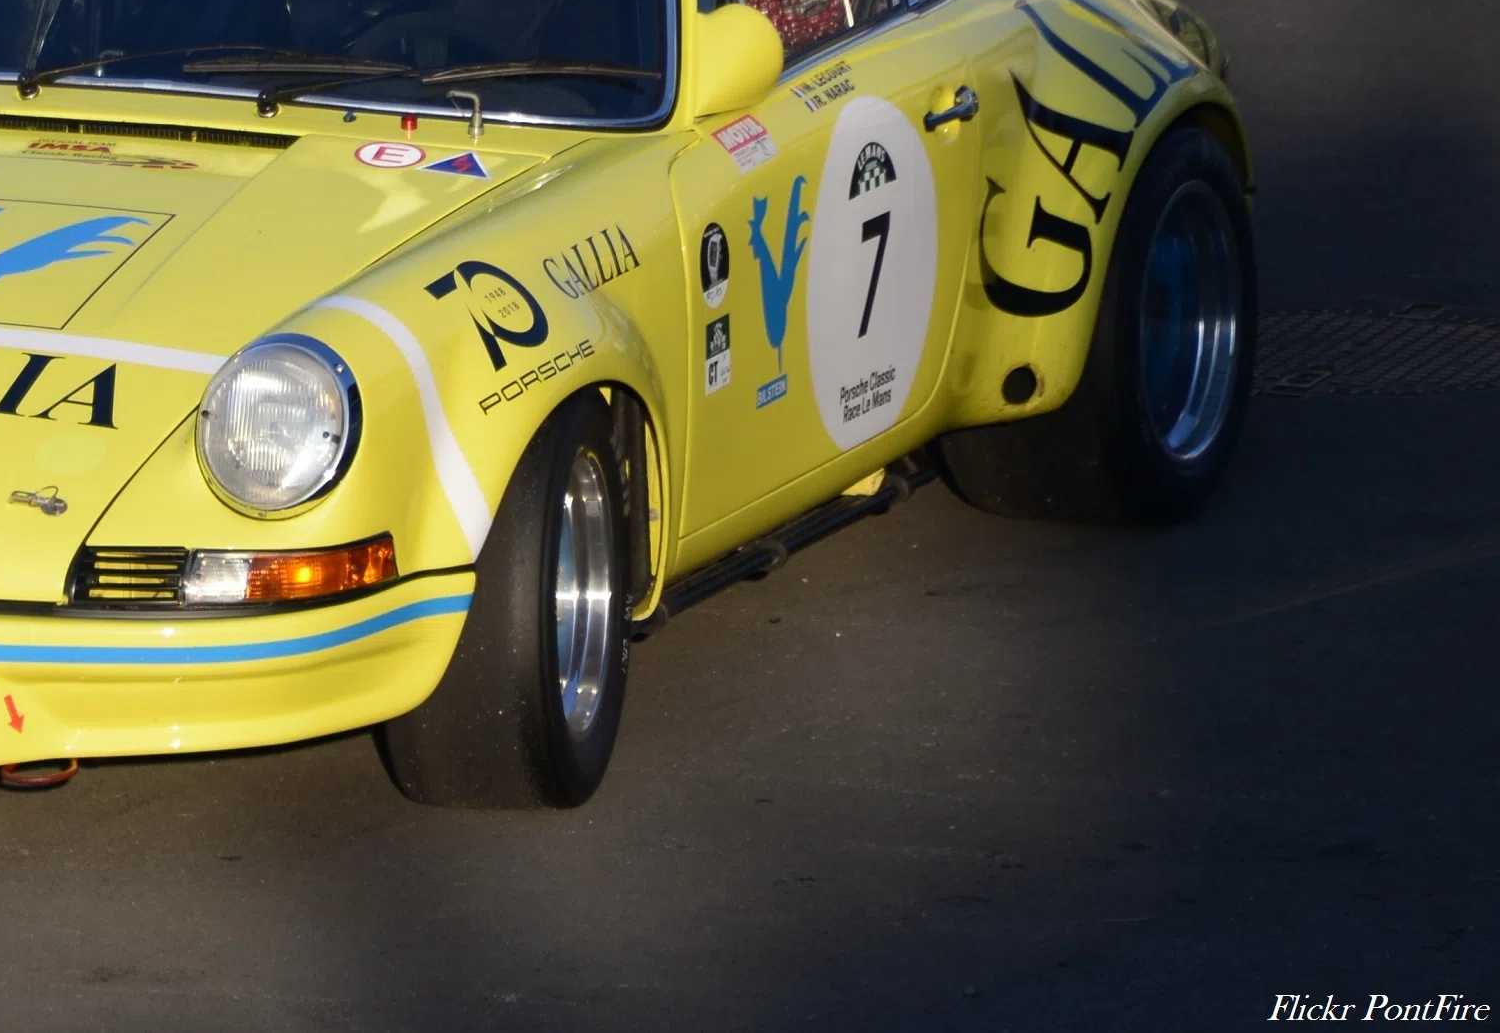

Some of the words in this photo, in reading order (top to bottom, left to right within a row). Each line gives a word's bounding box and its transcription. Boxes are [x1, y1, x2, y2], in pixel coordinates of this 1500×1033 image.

[823, 79, 855, 102] NARAC
[28, 142, 112, 154] IMSA
[716, 117, 765, 150] MOTUL
[371, 145, 411, 164] E
[542, 224, 641, 300] GALLIA
[857, 210, 891, 339] 7
[484, 286, 507, 304] 1948
[497, 301, 521, 319] 2018
[478, 339, 596, 416] PORSCHE
[758, 378, 787, 406] BILSTEIN
[839, 378, 869, 406] Porsche
[869, 364, 897, 391] Classic
[842, 403, 861, 425] Race
[861, 396, 872, 415] Le
[871, 388, 892, 411] Mans
